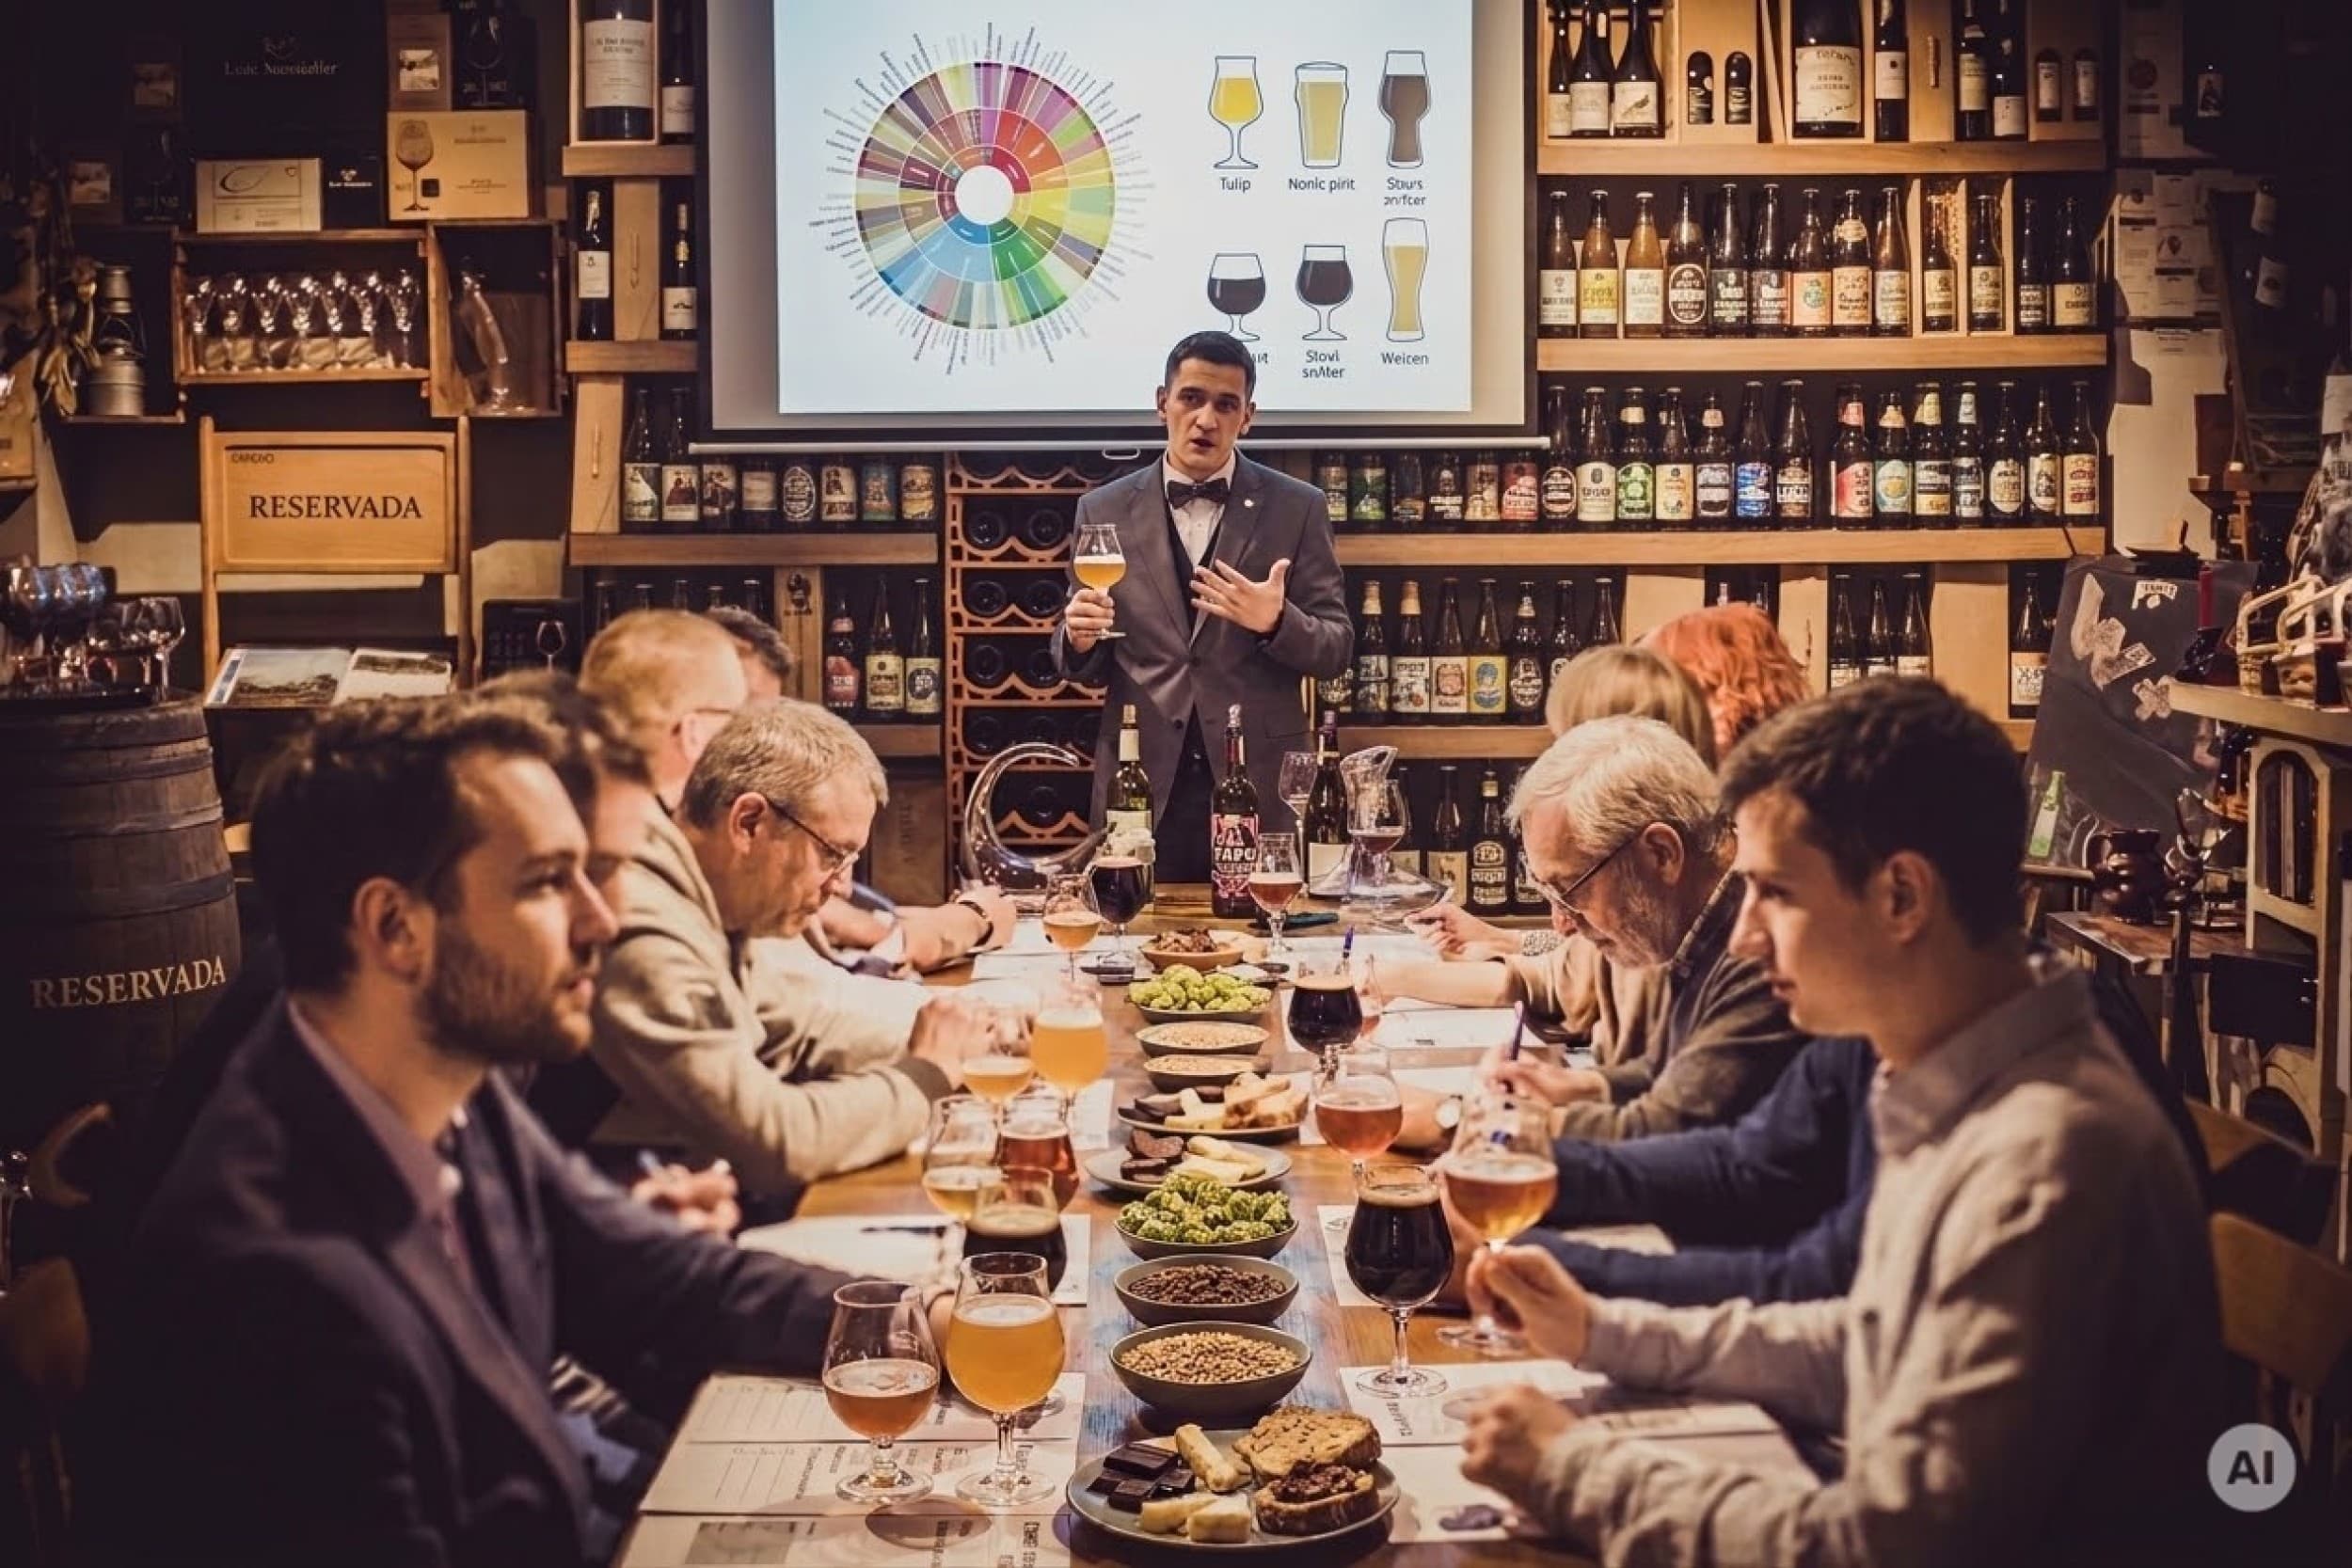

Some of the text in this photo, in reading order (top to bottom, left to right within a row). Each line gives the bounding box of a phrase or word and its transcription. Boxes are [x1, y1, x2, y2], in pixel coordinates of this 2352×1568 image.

[1220, 177, 1251, 194] Tulip
[249, 495, 422, 519] RESERVADA
[29, 954, 227, 1009] RESERVADA
